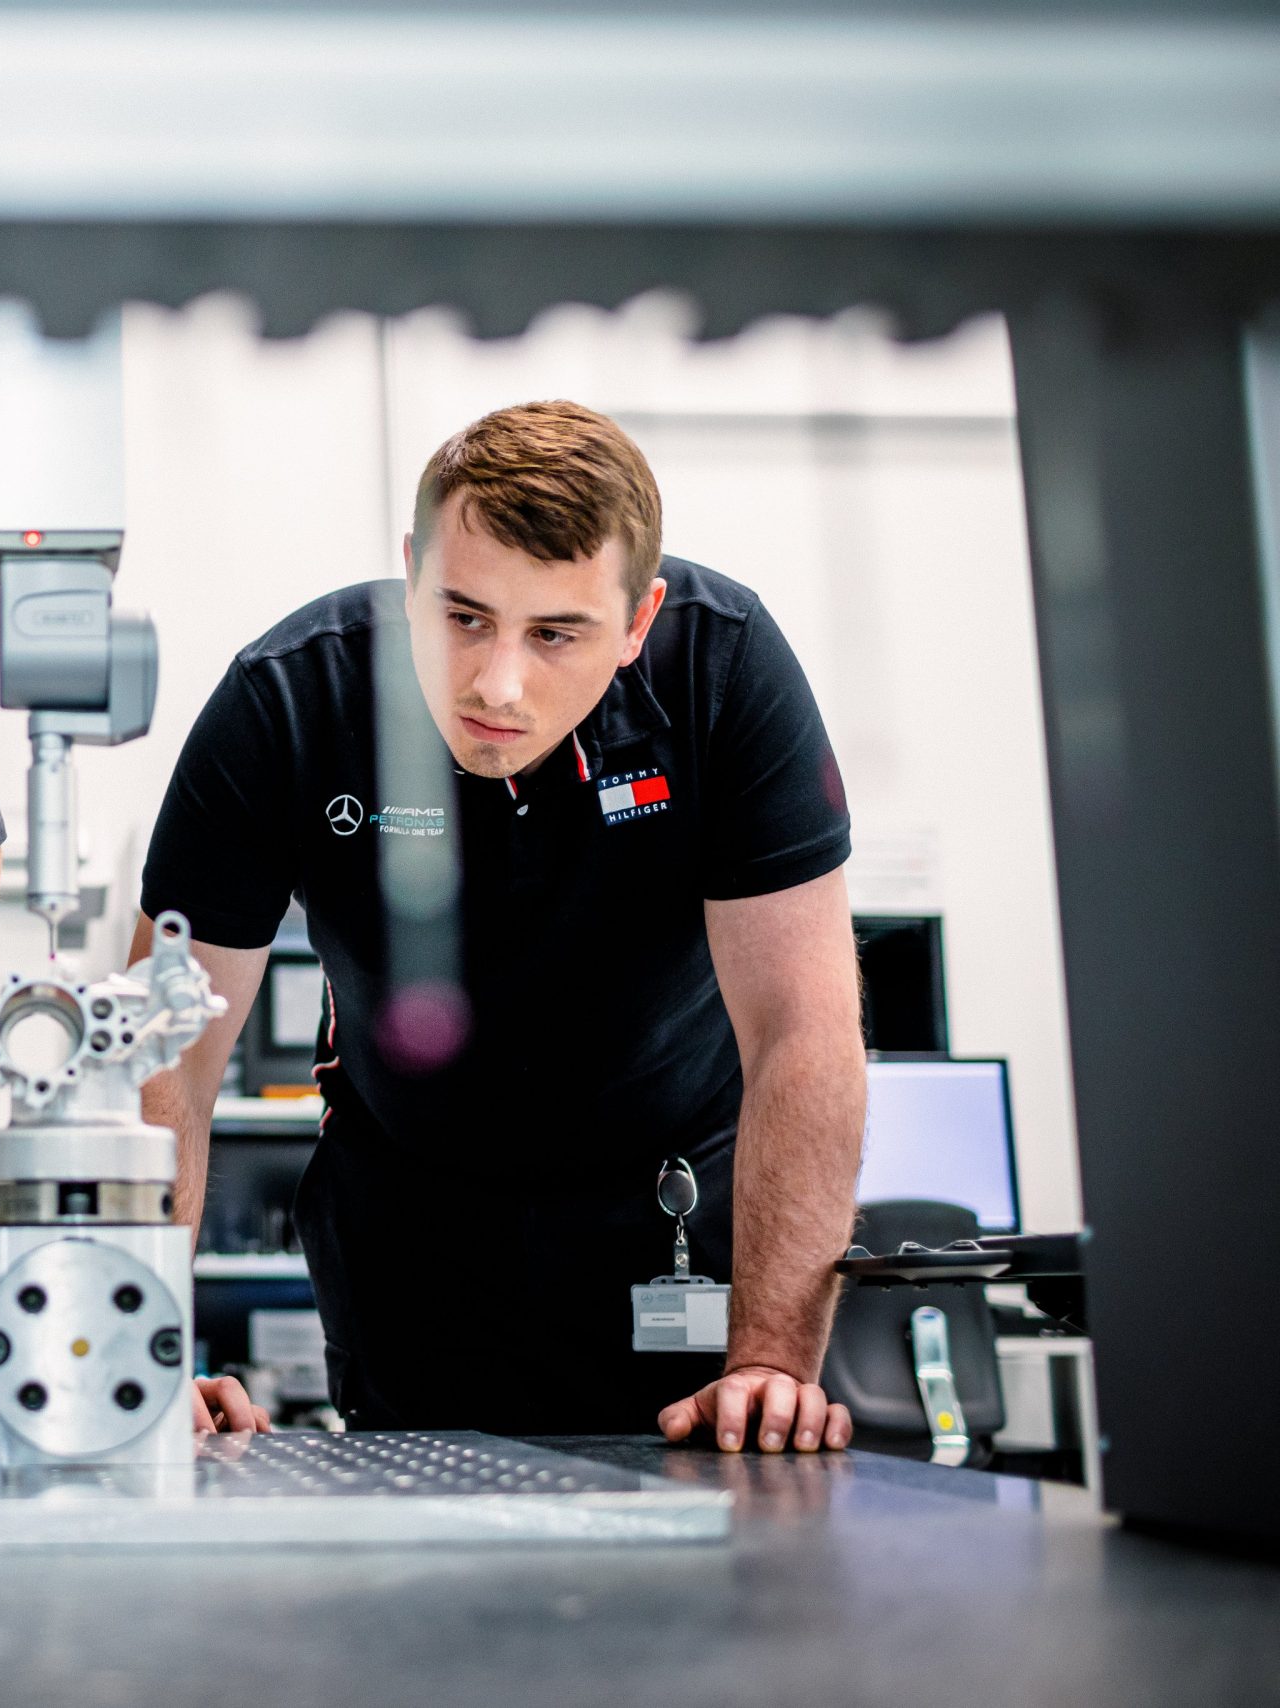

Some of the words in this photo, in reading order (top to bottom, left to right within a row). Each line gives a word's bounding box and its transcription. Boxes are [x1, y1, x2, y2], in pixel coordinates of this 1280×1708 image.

[601, 768, 658, 787] TOMMY
[608, 802, 668, 822] HILFIGER
[369, 814, 445, 828] PETRONAS
[380, 825, 410, 835] FORMULA
[411, 828, 426, 836] ONE
